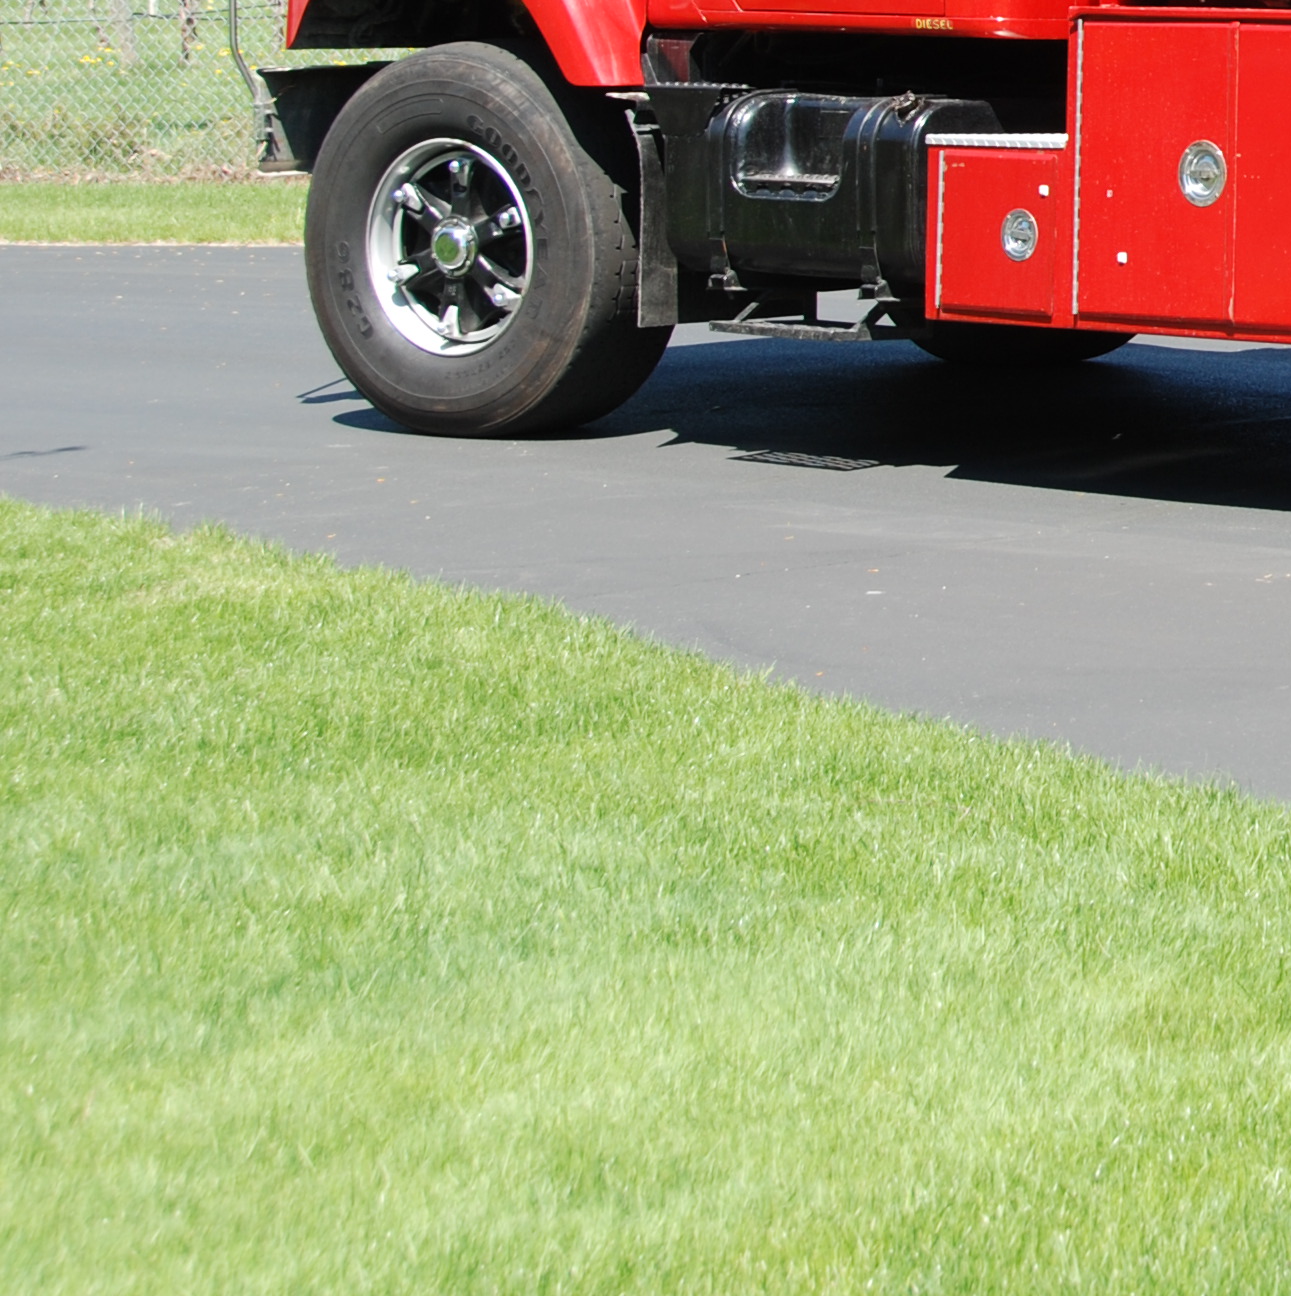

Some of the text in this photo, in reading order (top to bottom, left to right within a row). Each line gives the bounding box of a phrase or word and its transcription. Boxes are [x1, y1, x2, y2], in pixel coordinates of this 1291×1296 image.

[915, 18, 954, 30] DIESEL
[465, 114, 550, 321] GOODYEAR
[334, 240, 374, 341] G286
